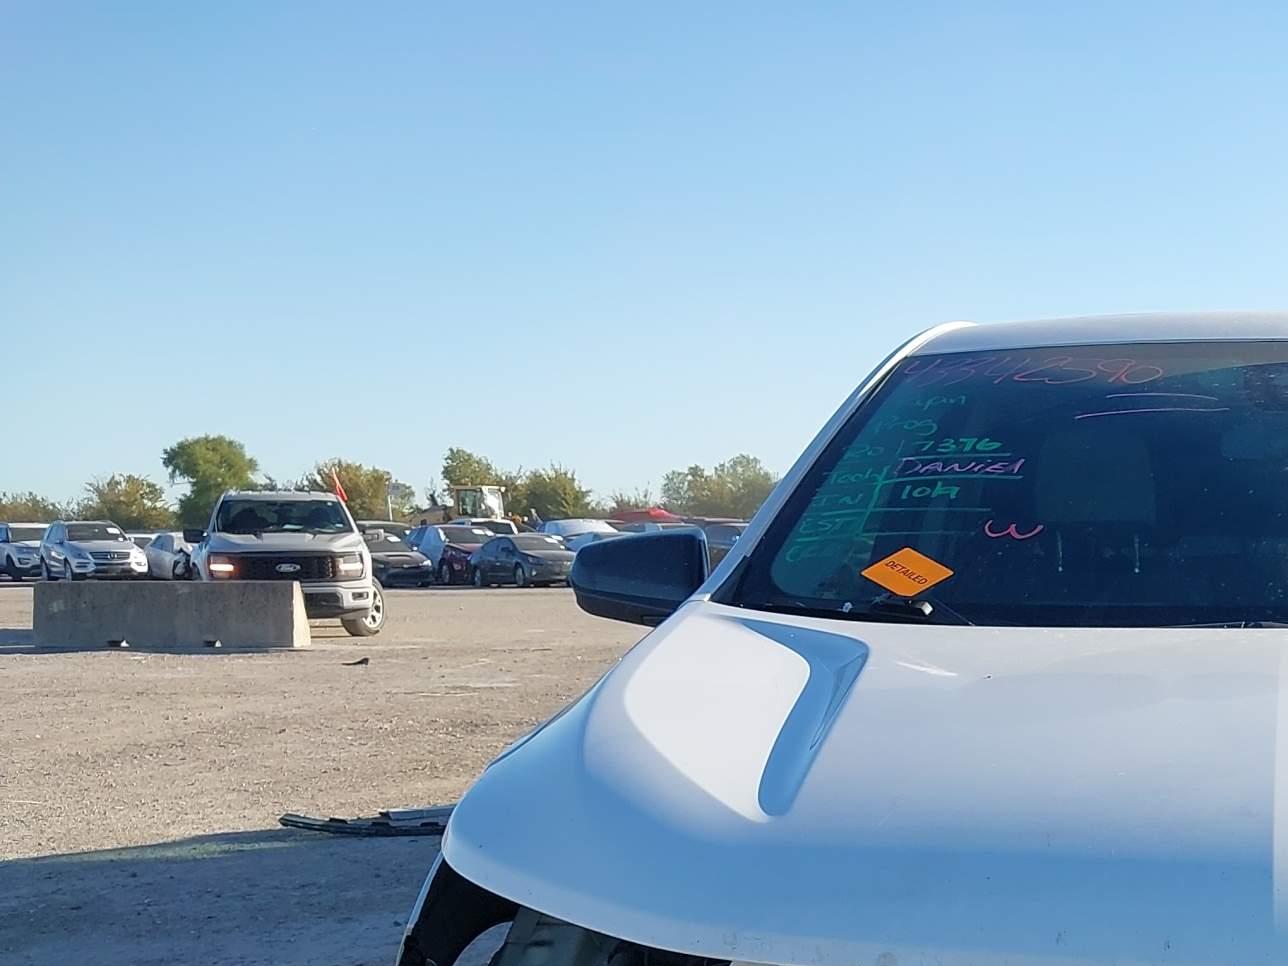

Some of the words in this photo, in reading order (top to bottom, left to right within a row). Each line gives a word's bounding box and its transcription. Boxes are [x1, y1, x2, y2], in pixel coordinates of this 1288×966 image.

[903, 356, 1163, 387] 43342590
[912, 438, 1003, 452] 7376
[884, 560, 929, 585] DETAILED
